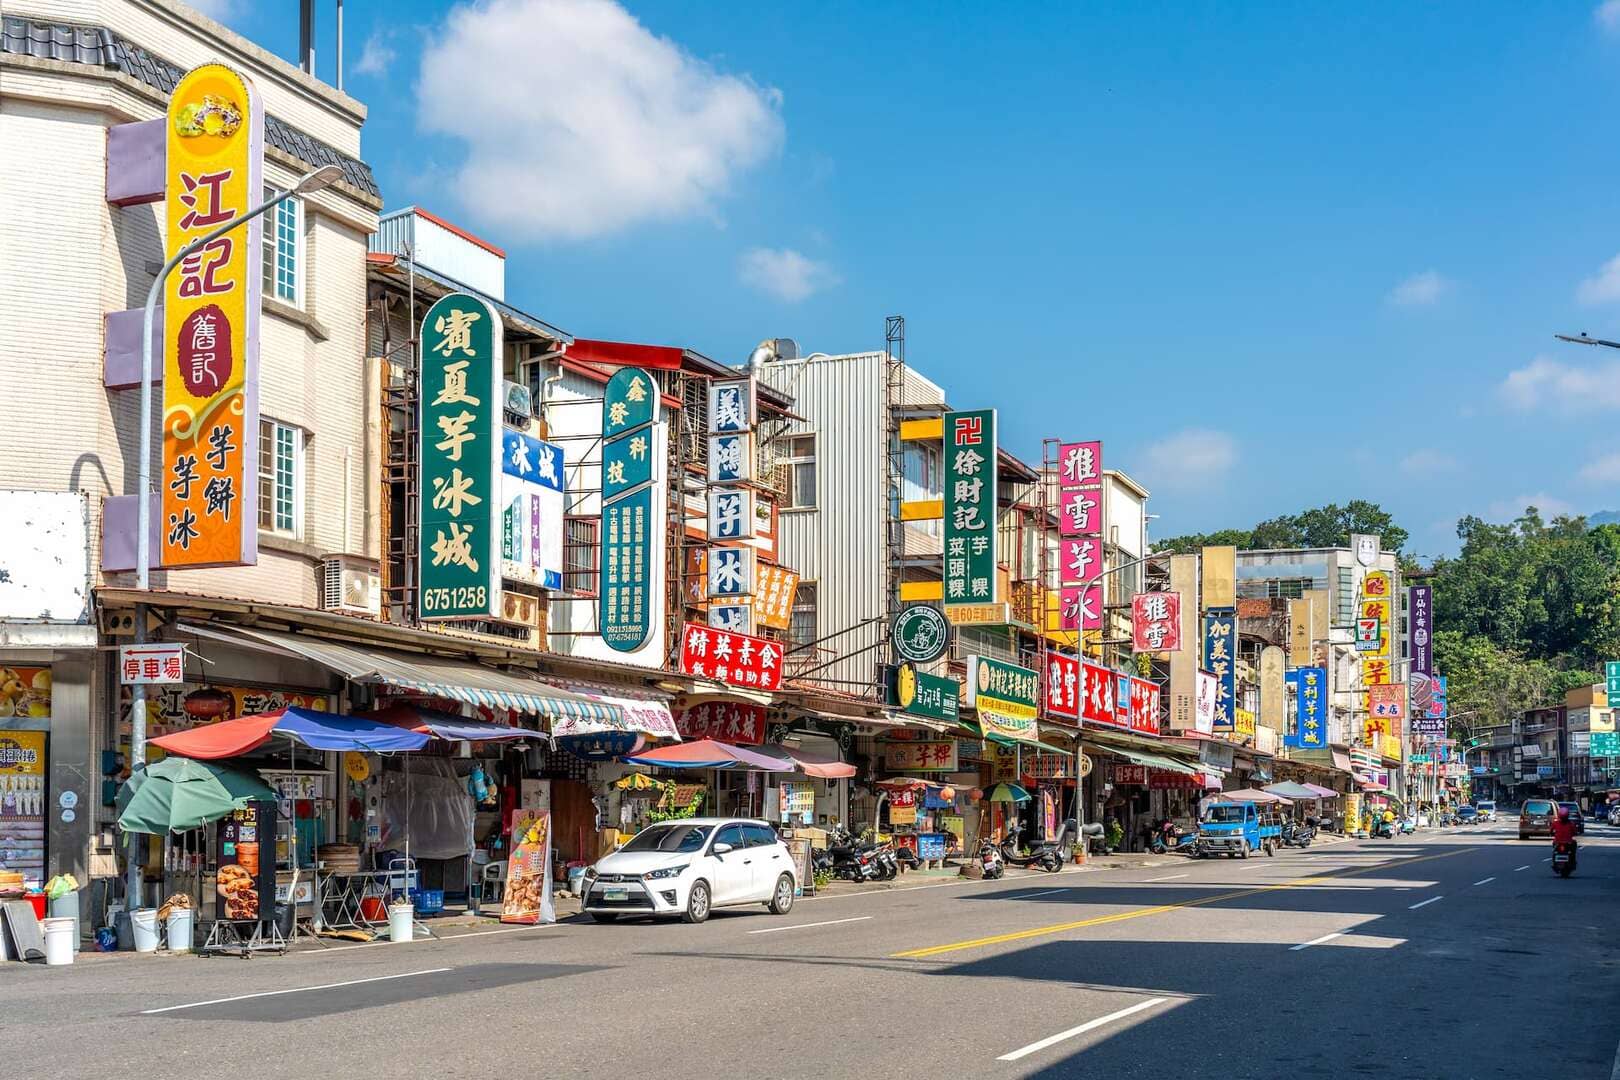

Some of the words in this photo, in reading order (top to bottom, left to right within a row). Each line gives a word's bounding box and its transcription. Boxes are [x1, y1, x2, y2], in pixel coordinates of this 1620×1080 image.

[179, 169, 235, 297] 江記
[191, 313, 219, 387] 舊記
[204, 426, 235, 522] 芋餅
[431, 309, 482, 573] 賓夏芋冰城
[168, 455, 200, 551] 芋冰
[953, 449, 985, 530] 徐財記
[948, 537, 965, 598] 菜頭粿
[971, 536, 989, 597] 芋粿
[1063, 448, 1098, 623] 雅雪芋冰
[424, 586, 486, 610] 6751258
[1143, 597, 1169, 649] 雅雪
[123, 657, 182, 681] 停車場
[688, 629, 780, 669] 精英素食
[1303, 672, 1320, 744] 吉利芋冰城
[915, 744, 951, 768] 芋粿
